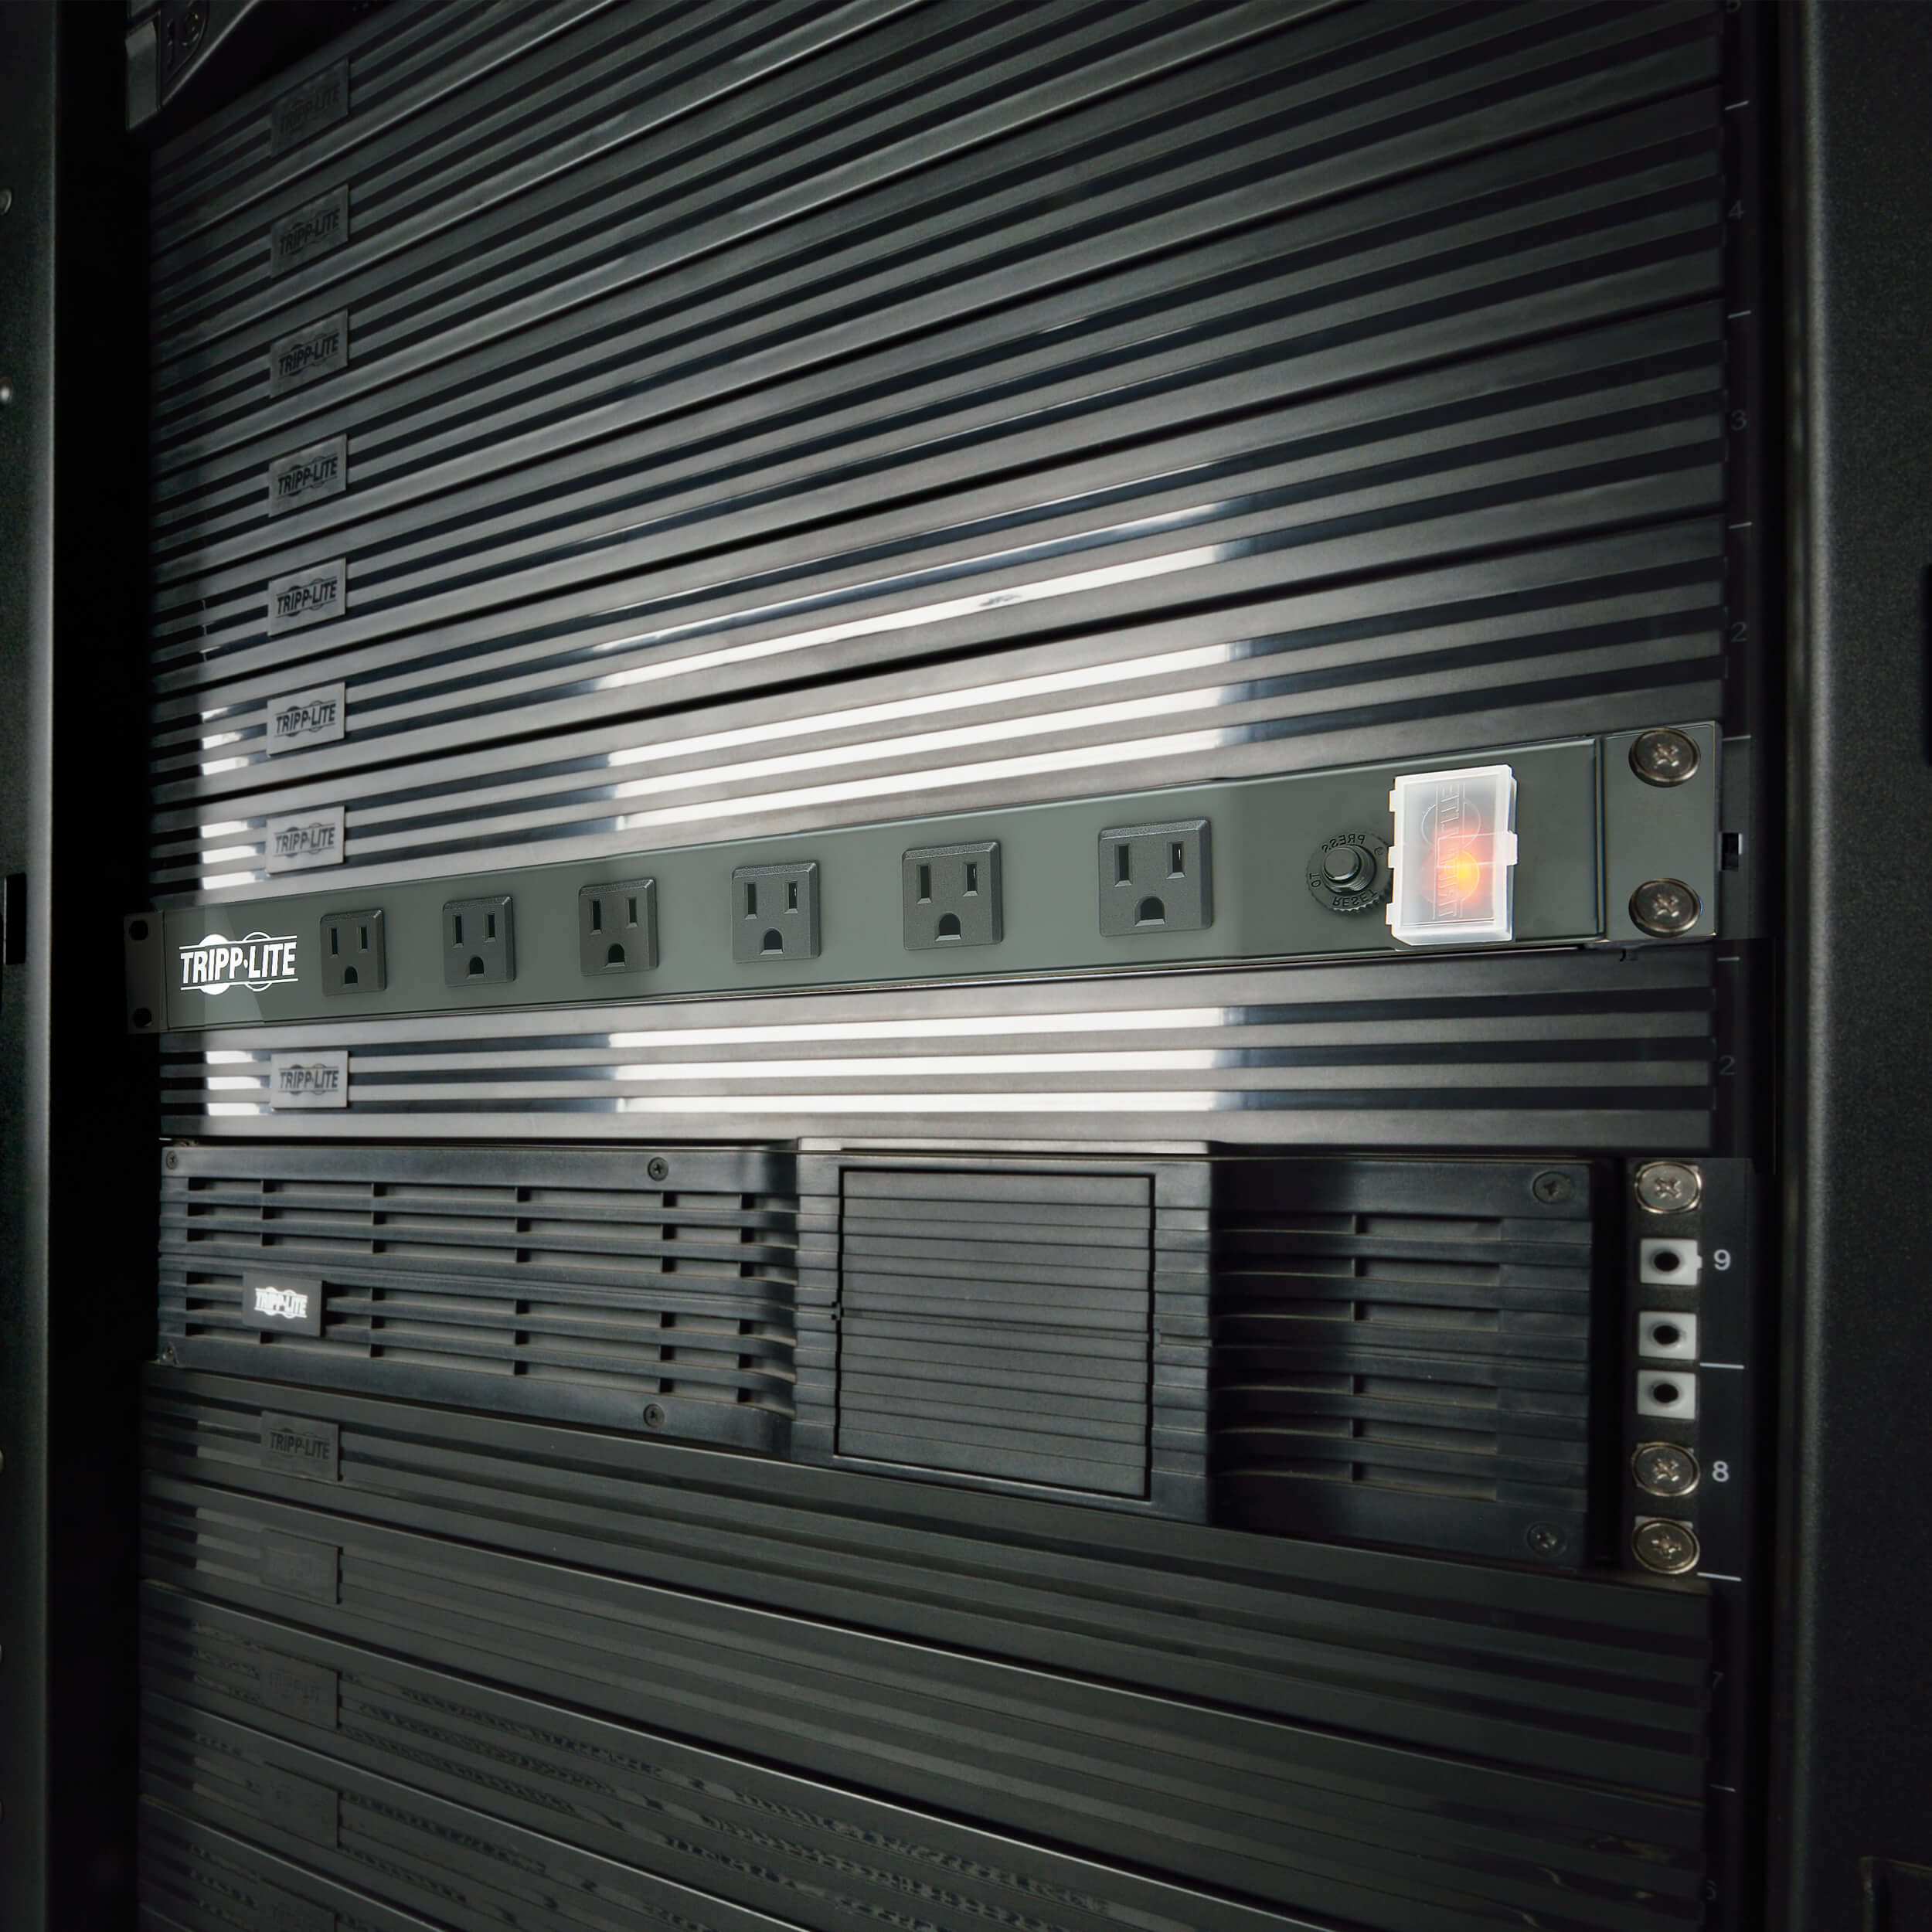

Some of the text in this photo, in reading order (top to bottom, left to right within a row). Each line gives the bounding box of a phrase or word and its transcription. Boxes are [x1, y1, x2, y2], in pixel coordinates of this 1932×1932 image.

[1728, 199, 1745, 223] 4
[1730, 409, 1747, 431] 3
[1730, 621, 1747, 643] 2
[1718, 1055, 1737, 1077] 2
[1713, 1248, 1733, 1272] 9
[1711, 1460, 1730, 1484] 8
